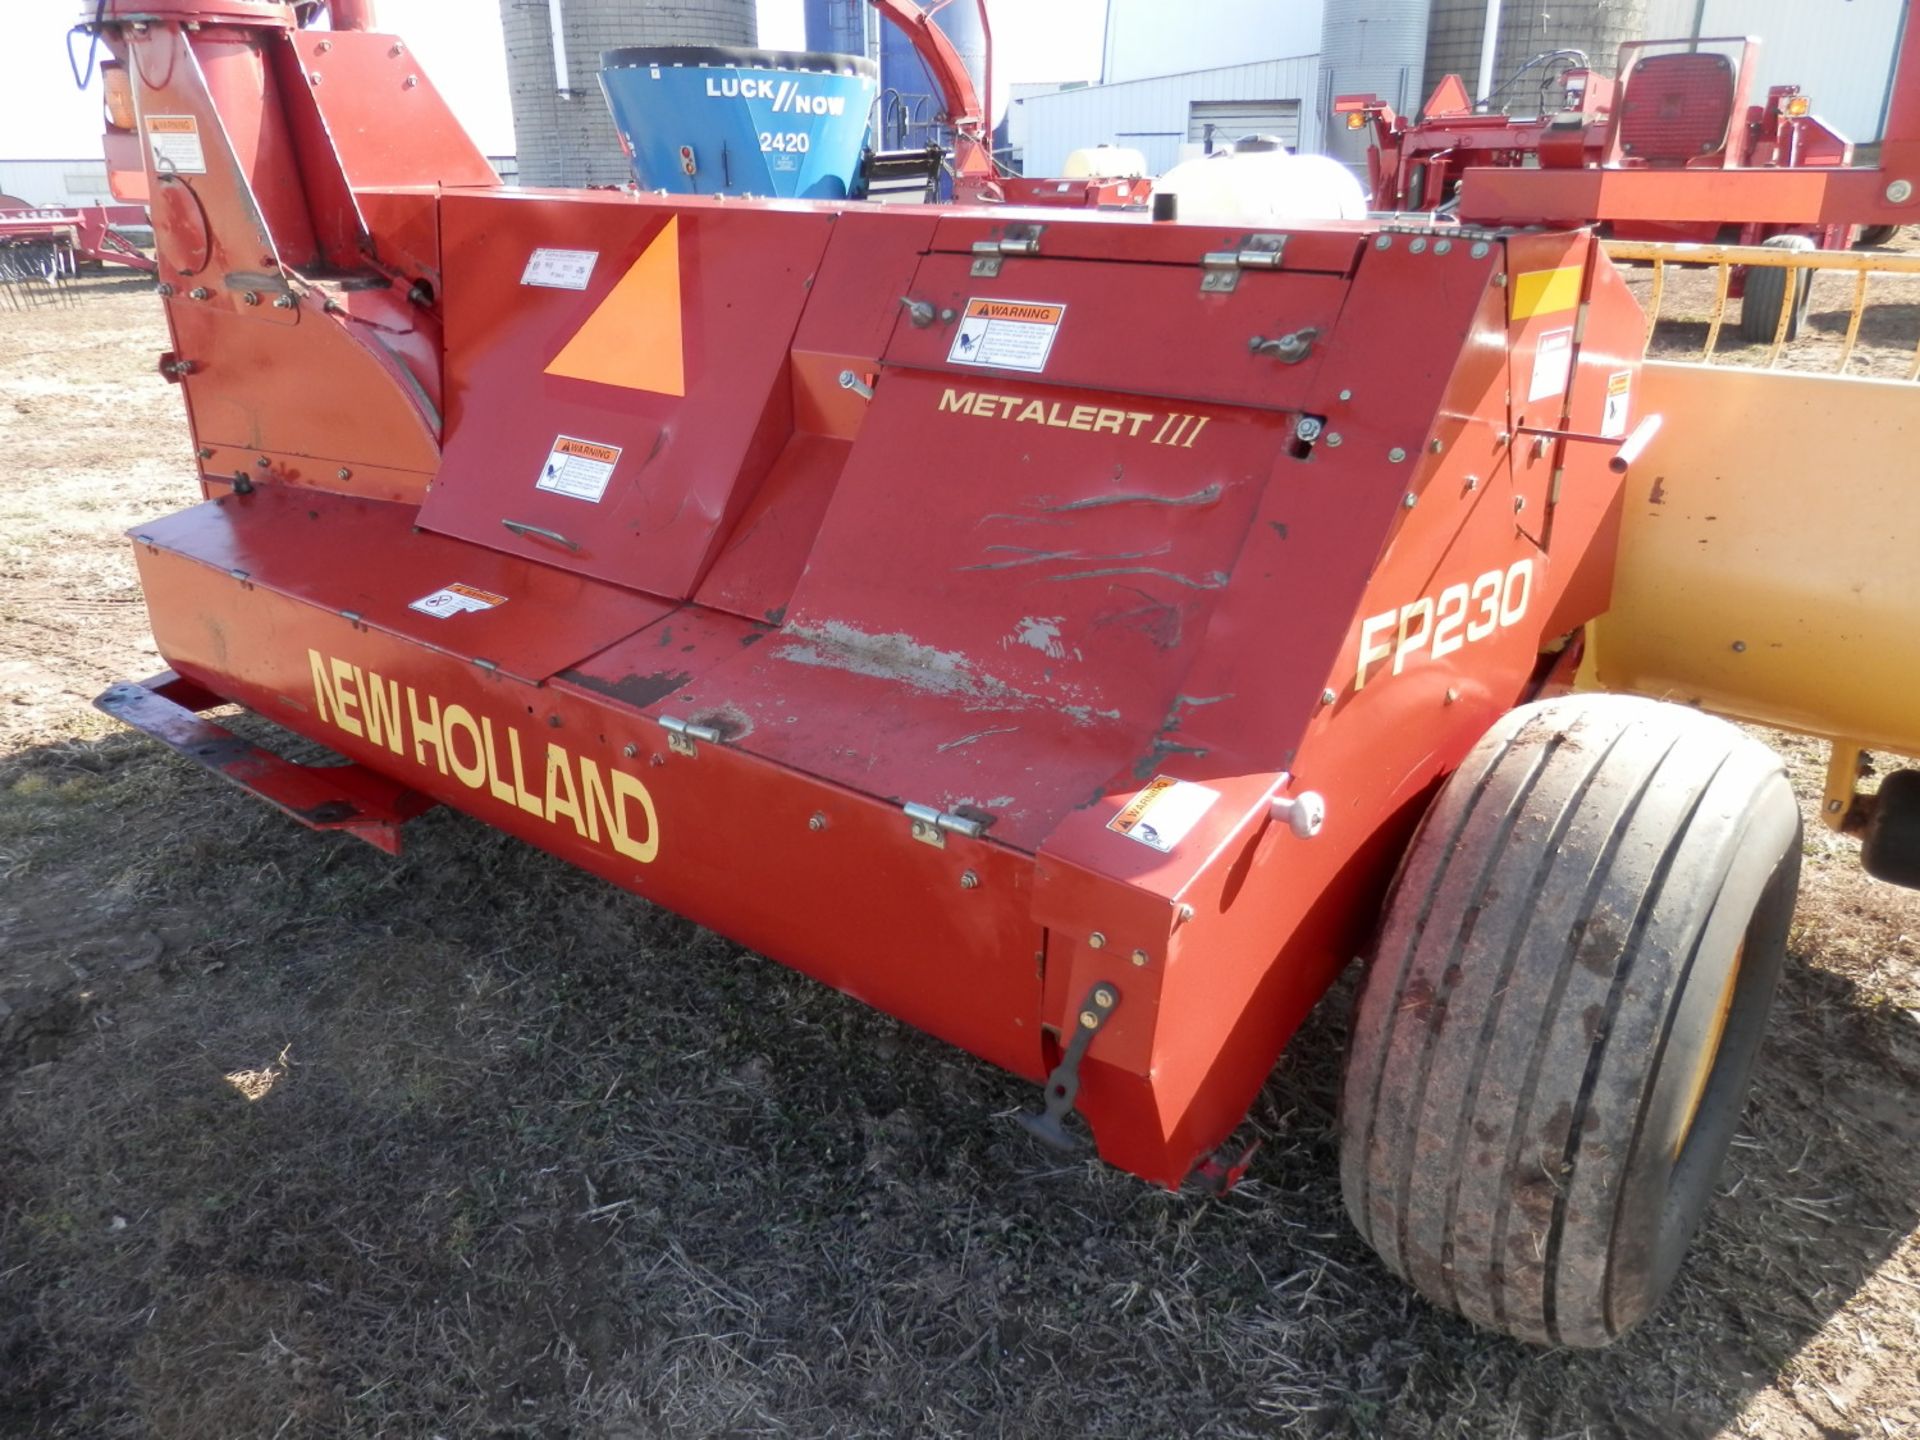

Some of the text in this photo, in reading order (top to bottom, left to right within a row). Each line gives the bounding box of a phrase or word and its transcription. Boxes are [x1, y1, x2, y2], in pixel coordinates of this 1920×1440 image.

[759, 132, 810, 153] 2420
[991, 305, 1050, 320] WARNING
[938, 388, 1153, 437] METALERT
[570, 442, 612, 460] WARNING
[1354, 558, 1534, 692] FP230
[308, 647, 659, 864] NEW HOLLAND
[1126, 781, 1169, 818] WARNING
